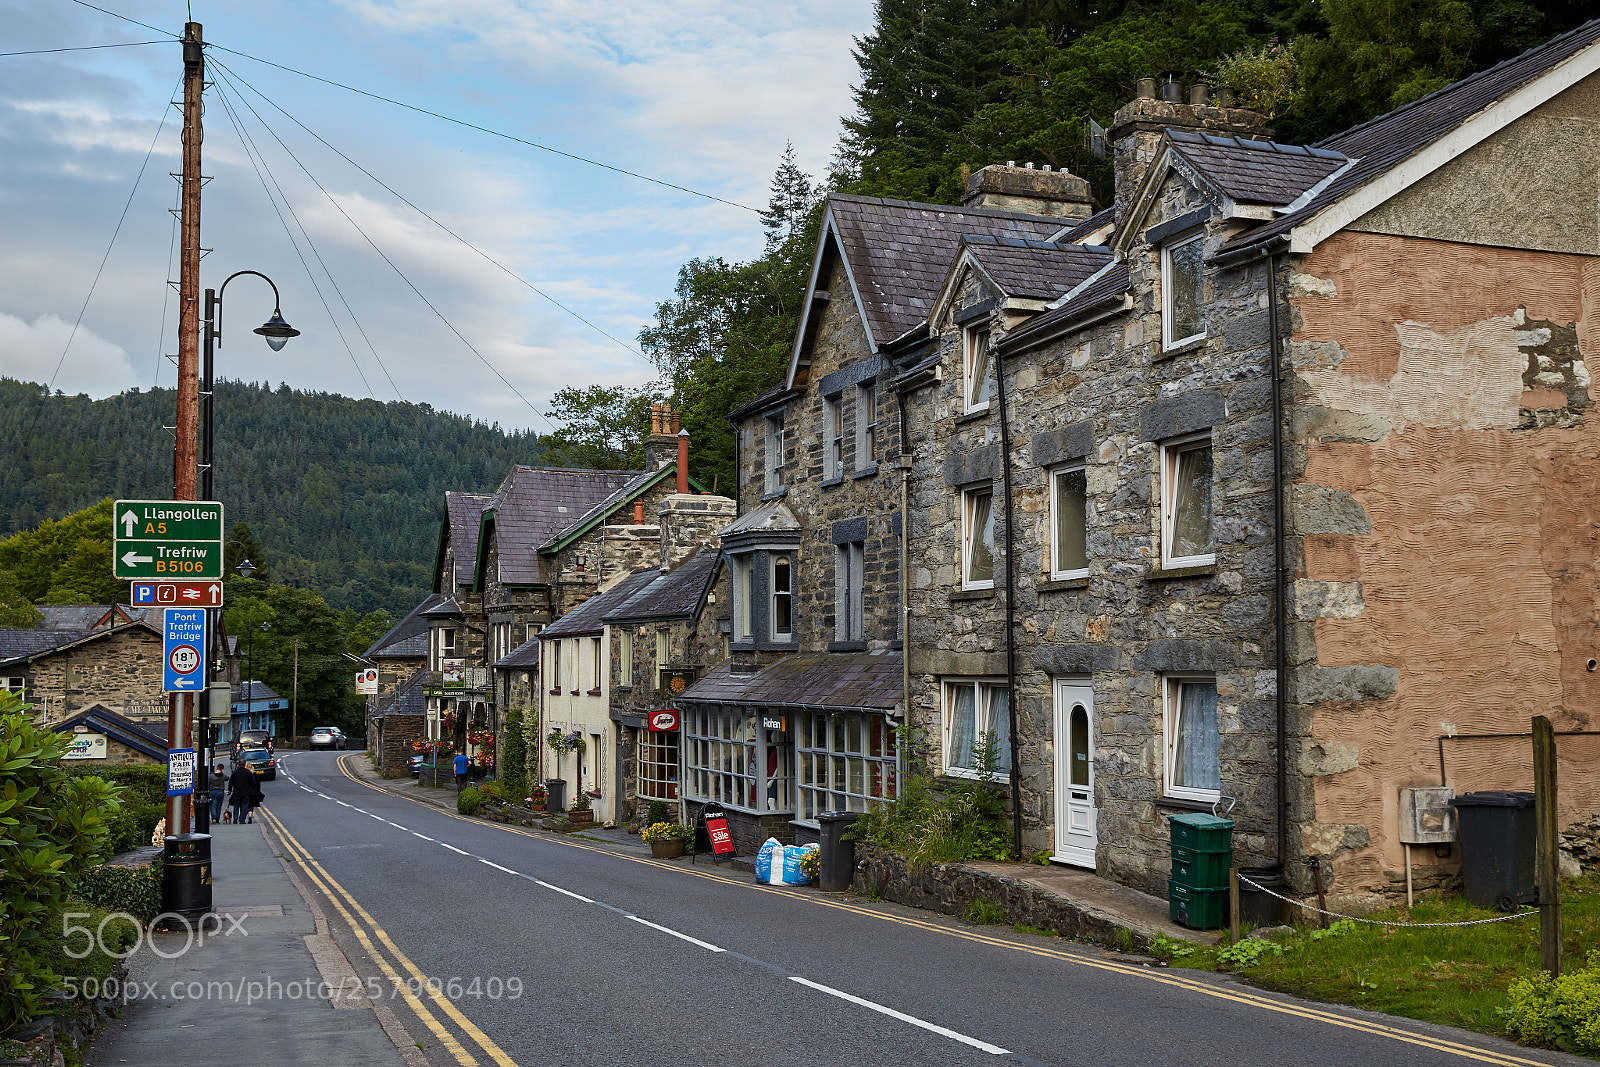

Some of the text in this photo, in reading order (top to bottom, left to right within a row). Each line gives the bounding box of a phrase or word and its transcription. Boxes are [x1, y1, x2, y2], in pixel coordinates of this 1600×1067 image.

[144, 507, 217, 522] Llangollen
[156, 546, 207, 558] Trefriw
[174, 612, 196, 621] Pont
[169, 622, 202, 631] Trefriw
[169, 632, 201, 642] Bridge
[763, 716, 781, 729] Rohan
[712, 830, 729, 841] Sale
